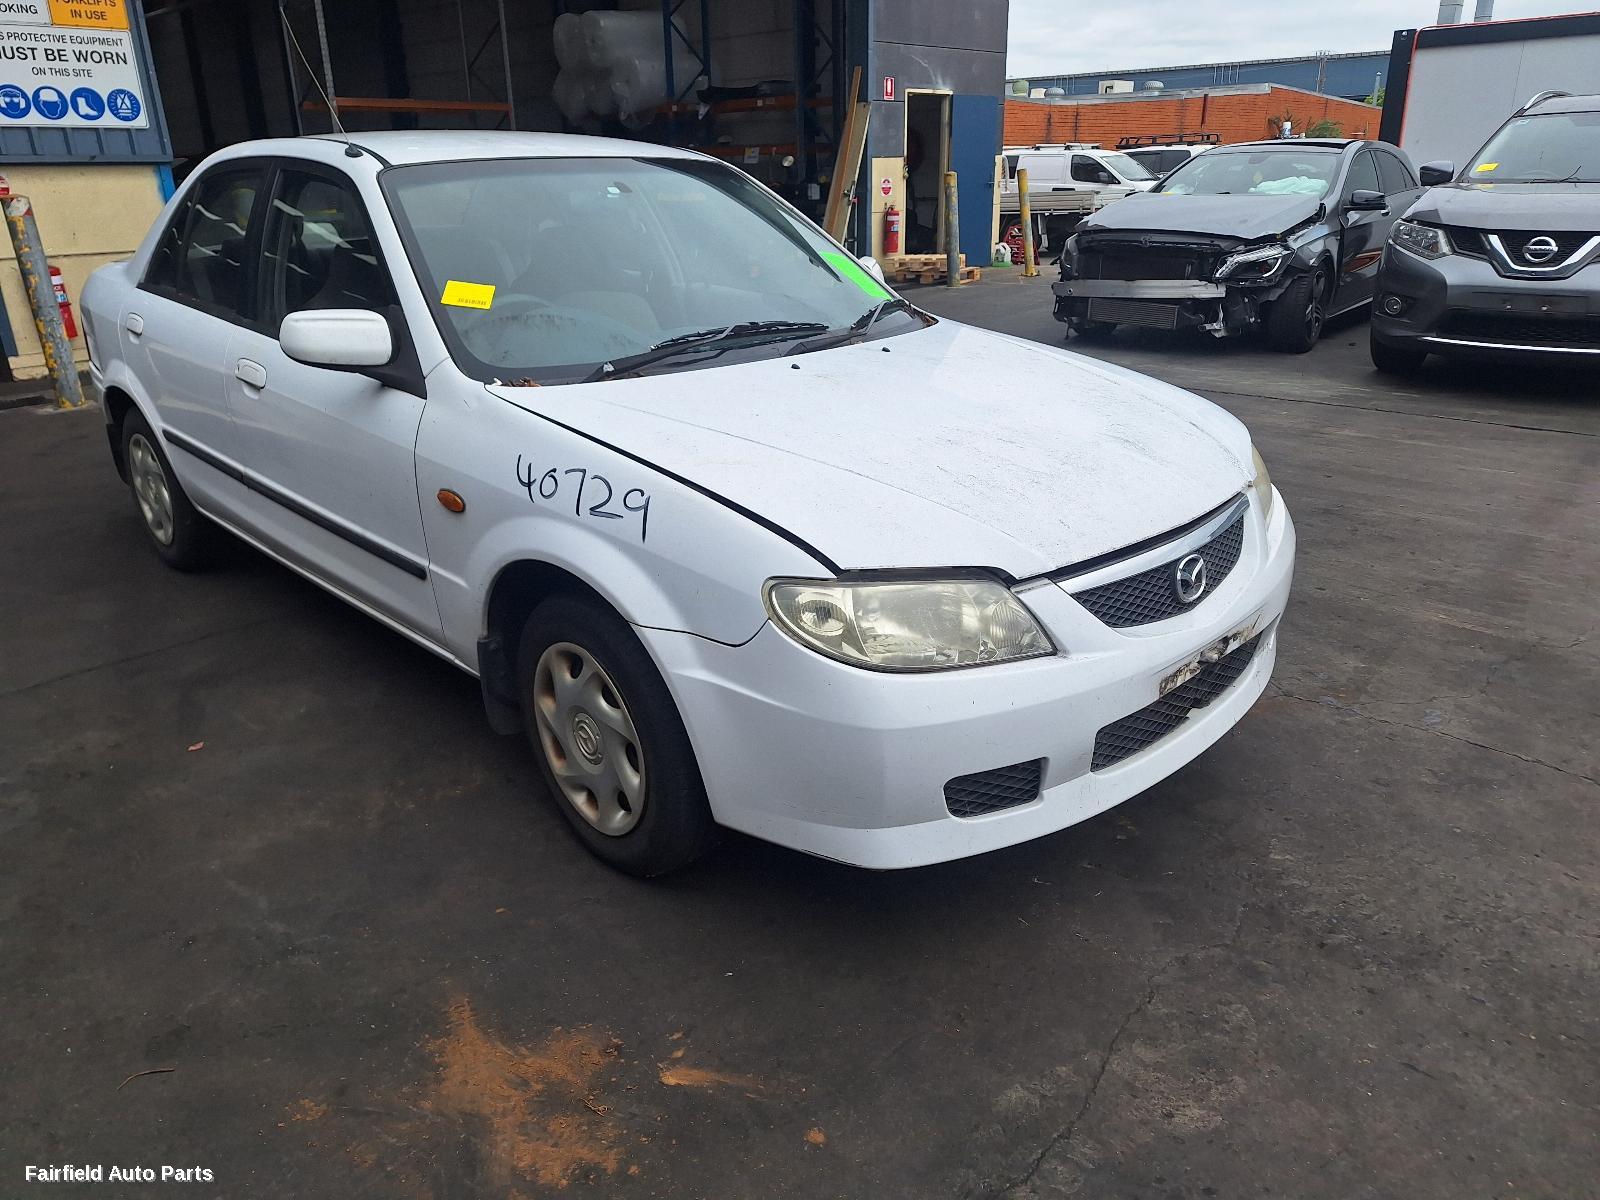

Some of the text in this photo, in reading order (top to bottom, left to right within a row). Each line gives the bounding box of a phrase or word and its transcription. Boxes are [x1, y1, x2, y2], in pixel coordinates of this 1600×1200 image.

[0, 3, 38, 14] OKING
[70, 9, 107, 20] IN USE
[7, 32, 67, 43] PROTECTIVE
[70, 35, 123, 46] EQUIPMENT
[0, 46, 128, 65] UST BE WORN
[32, 66, 93, 78] ON THIS SITE
[516, 453, 651, 544] 40729
